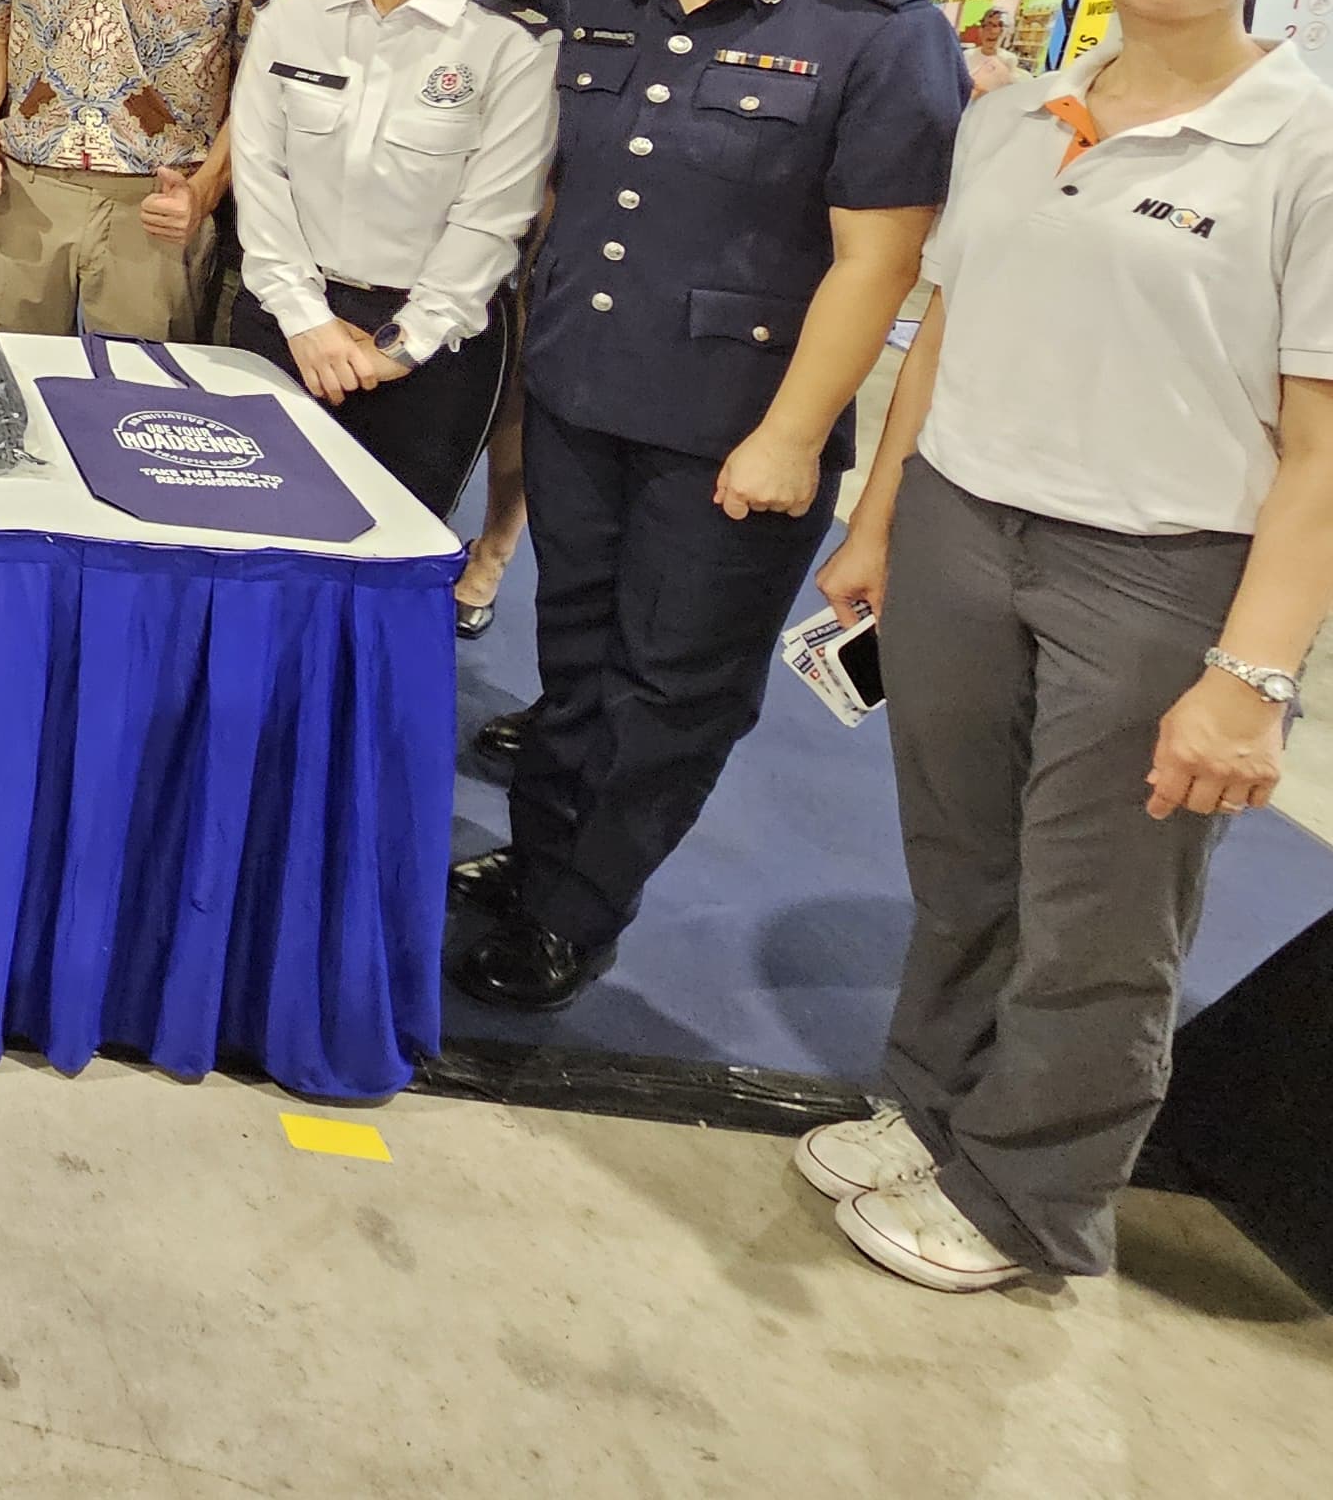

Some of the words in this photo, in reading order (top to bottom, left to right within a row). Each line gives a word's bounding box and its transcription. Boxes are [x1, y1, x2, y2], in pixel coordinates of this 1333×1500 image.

[145, 423, 172, 435] USE
[172, 425, 211, 438] YOUR
[120, 431, 259, 455] ROADSENSE
[139, 467, 180, 477] TAKE
[180, 469, 215, 479] THE
[214, 470, 259, 480] ROAD
[155, 475, 281, 490] RESPONSIBILITY
